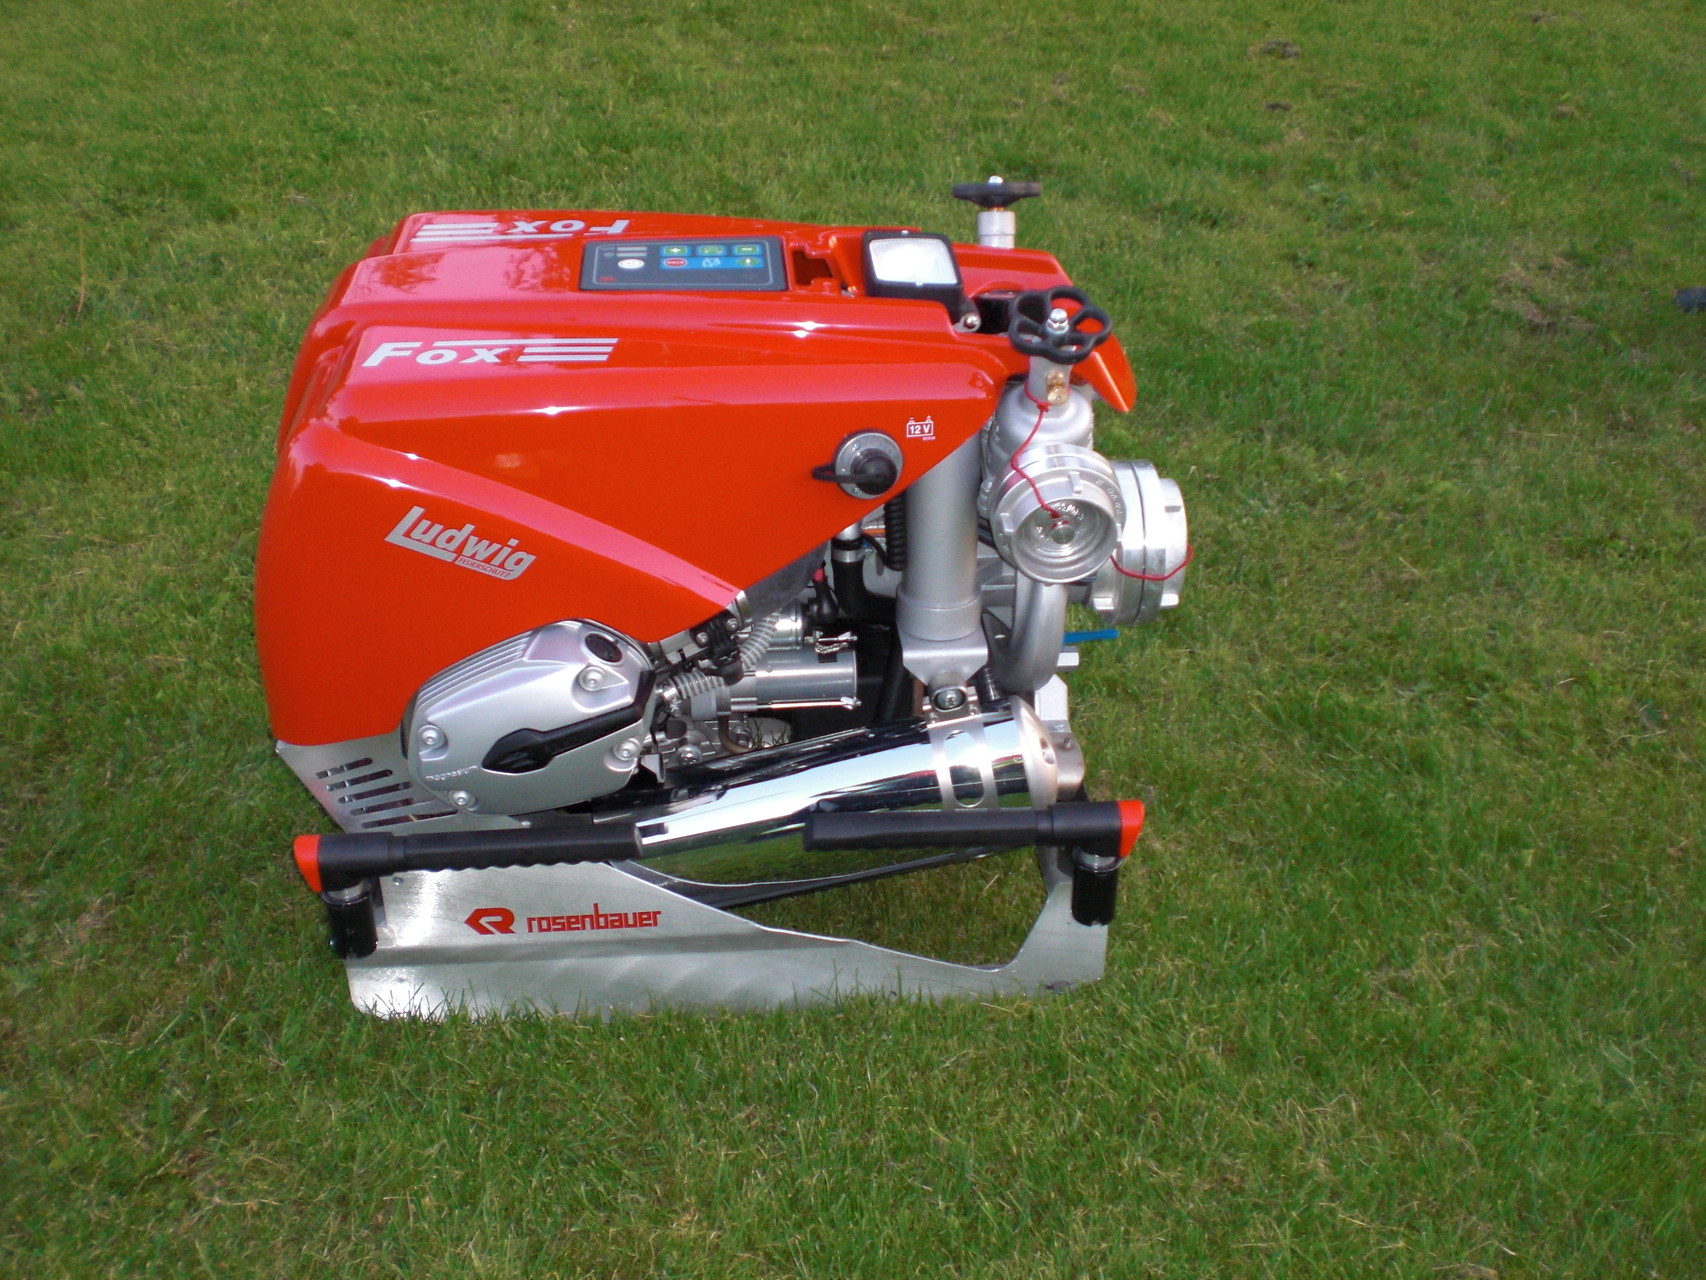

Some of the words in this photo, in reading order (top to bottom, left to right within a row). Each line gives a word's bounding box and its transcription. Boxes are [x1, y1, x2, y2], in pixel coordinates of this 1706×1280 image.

[909, 425, 921, 435] 12
[923, 424, 931, 434] V
[384, 505, 537, 580] Ludwig
[457, 557, 512, 579] FEUERSCHUTZ
[527, 903, 662, 934] rosenbauer
